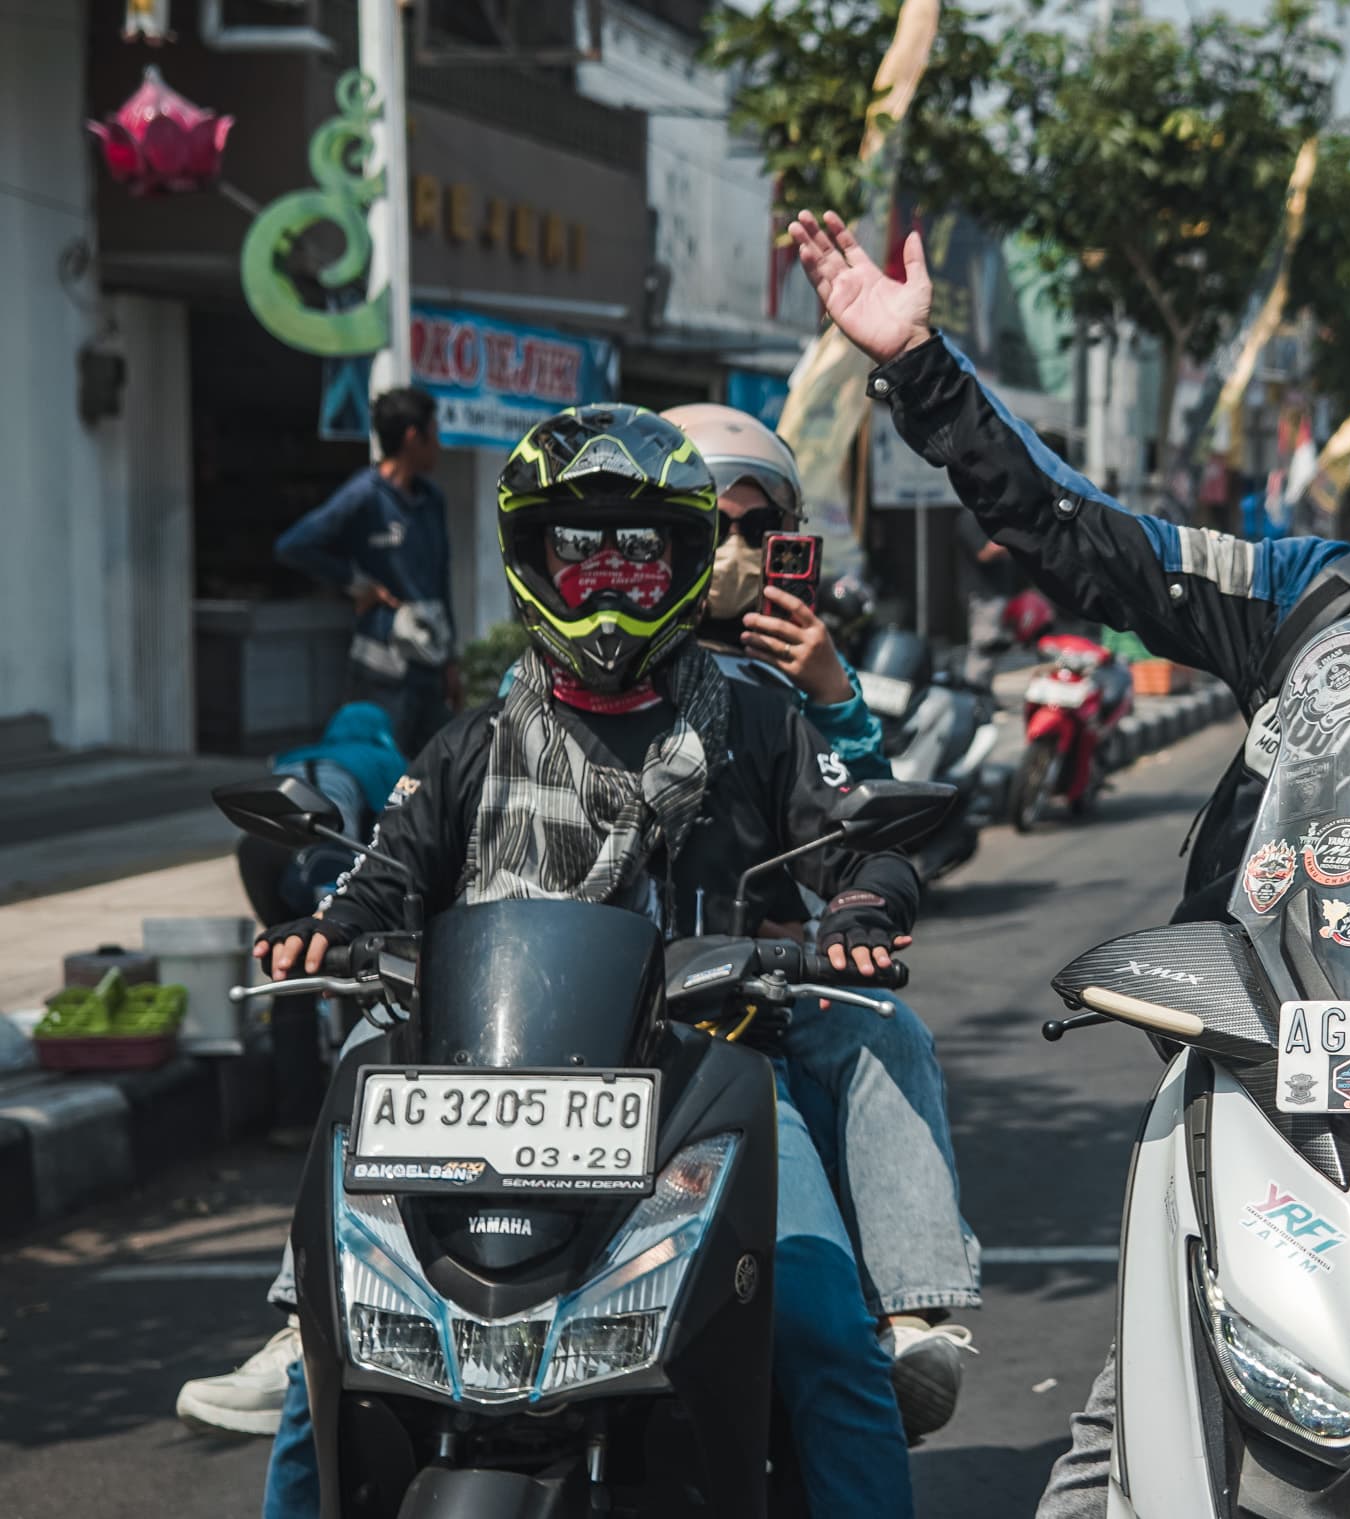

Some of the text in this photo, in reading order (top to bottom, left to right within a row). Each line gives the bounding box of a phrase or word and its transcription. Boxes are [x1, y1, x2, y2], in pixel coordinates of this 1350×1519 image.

[1286, 1007, 1346, 1053] AG
[374, 1088, 428, 1125] AG
[440, 1089, 547, 1126] 3205
[502, 1178, 645, 1189] SEMAKIN DI DEPAN
[469, 1216, 532, 1235] YAMAHA
[1241, 1220, 1318, 1273] JATIM
